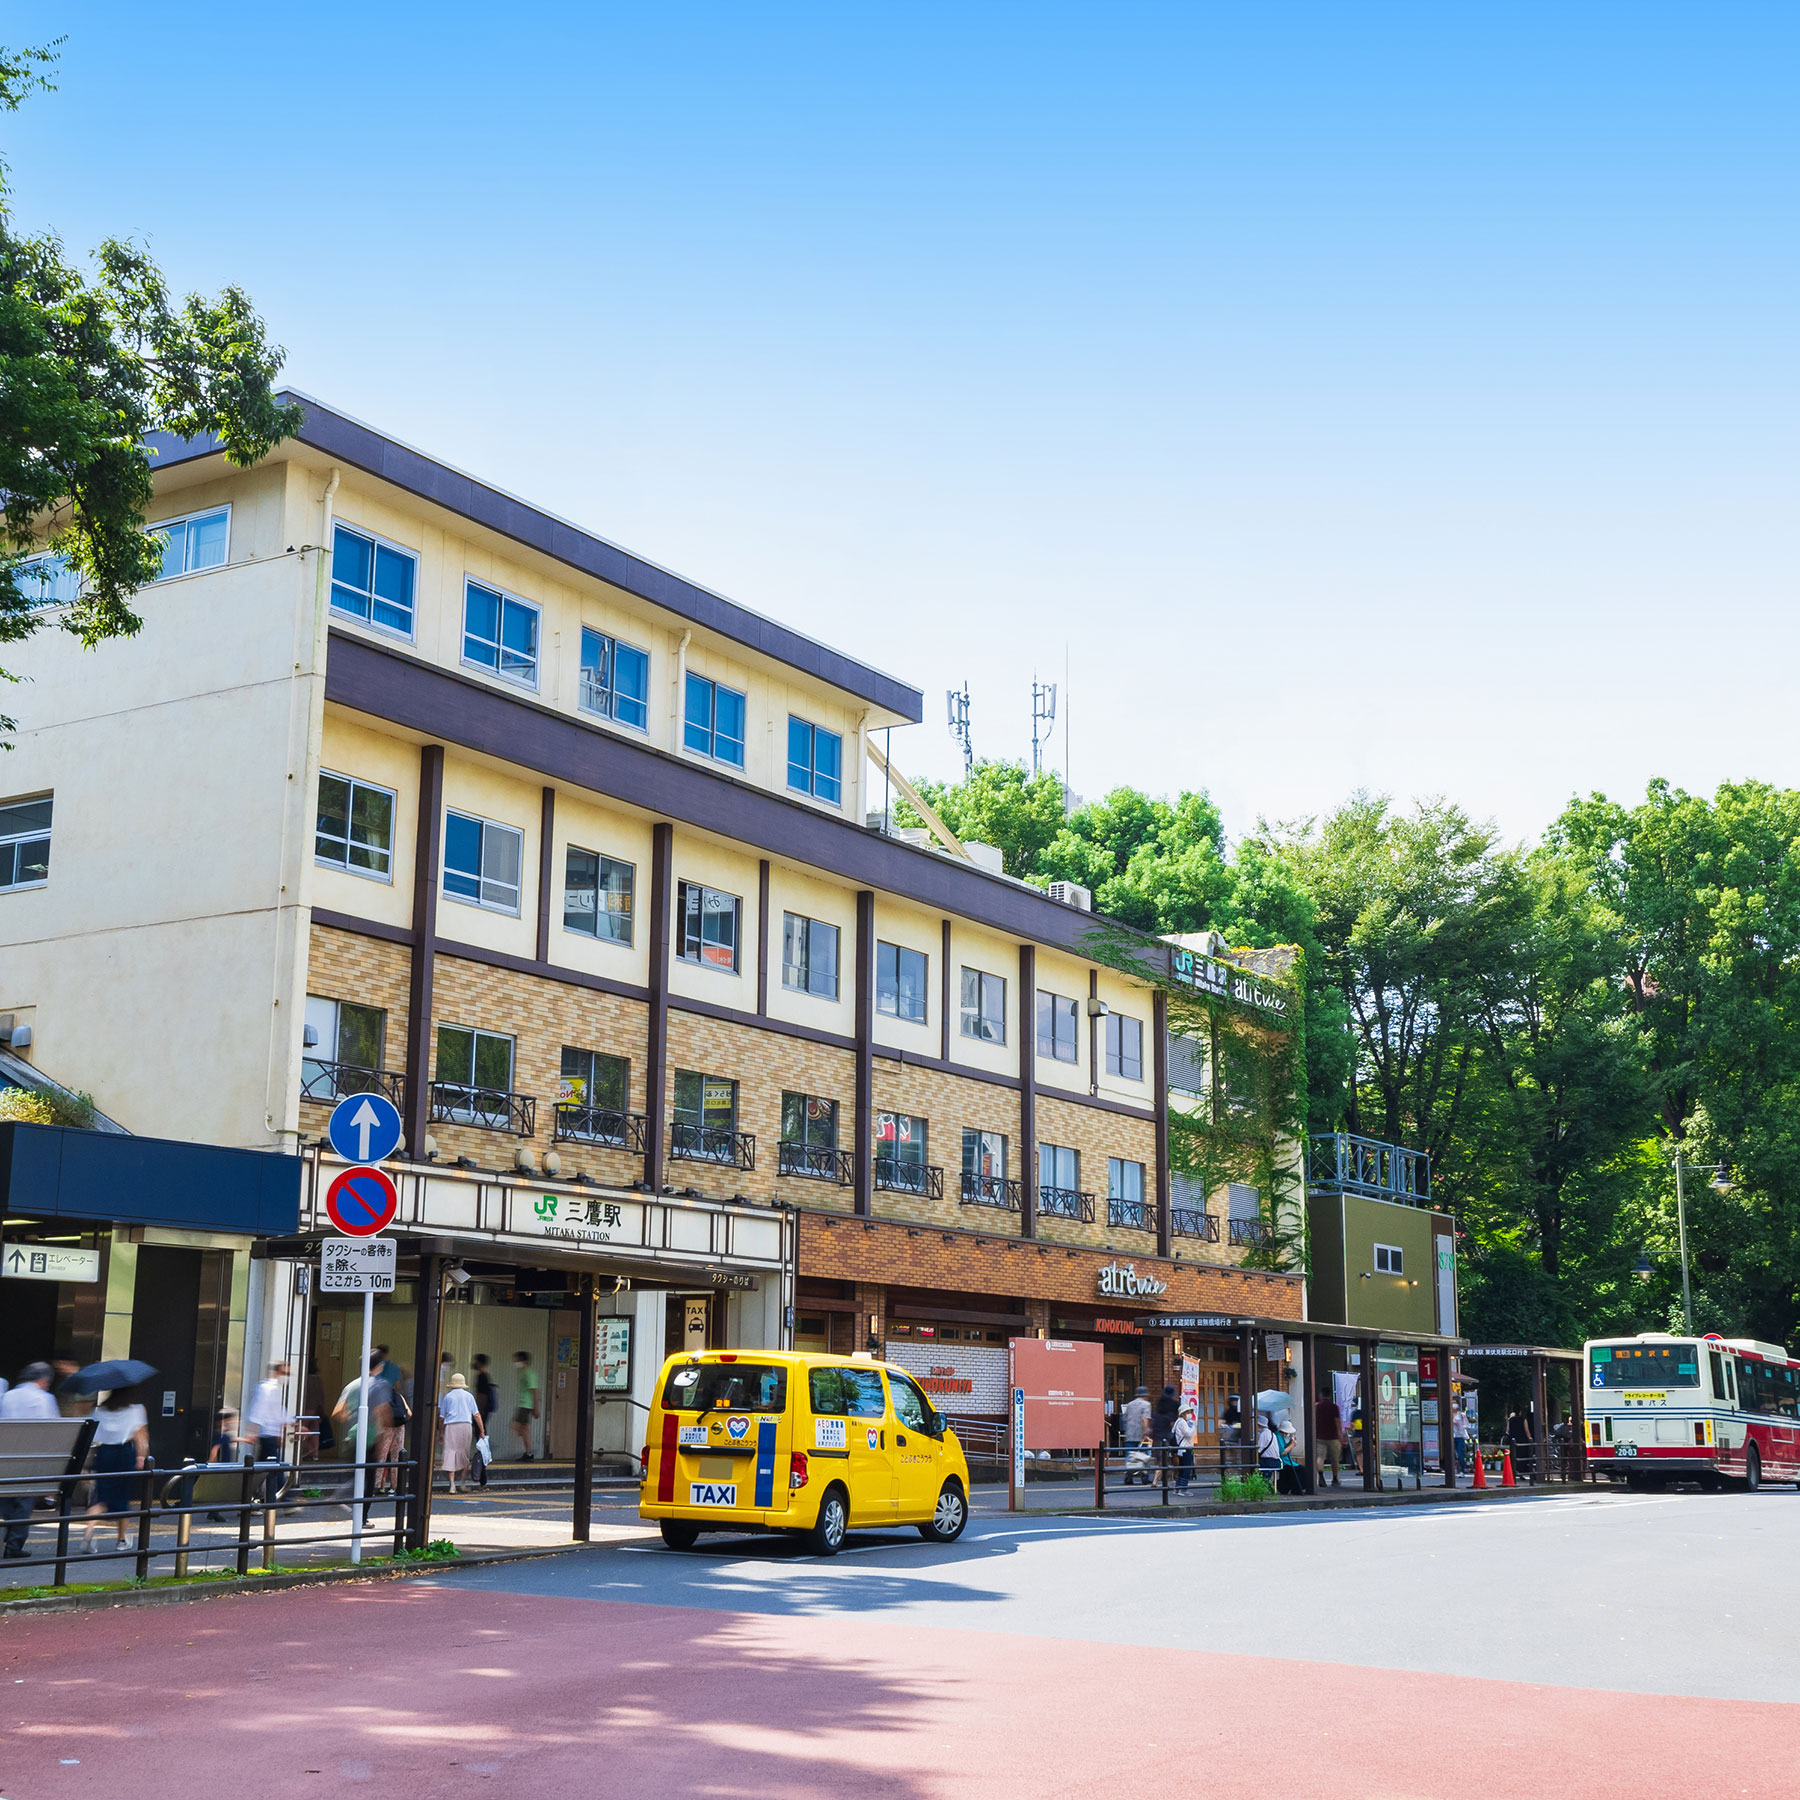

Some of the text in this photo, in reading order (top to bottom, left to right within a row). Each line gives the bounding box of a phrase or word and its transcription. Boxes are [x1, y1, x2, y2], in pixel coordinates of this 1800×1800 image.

[1175, 951, 1194, 975] JR
[534, 1194, 558, 1216] JR
[565, 1199, 622, 1228] 三鷹駅
[544, 1226, 611, 1241] MITAKA STATION
[326, 1244, 393, 1257] タクシーの客待ち
[48, 1254, 94, 1265] エレベーター
[325, 1258, 357, 1272] を除く
[325, 1274, 392, 1288] ここから 10m
[711, 1273, 750, 1287] タクシーのりば
[1424, 1362, 1431, 1376] 1
[692, 1484, 736, 1505] TAXI
